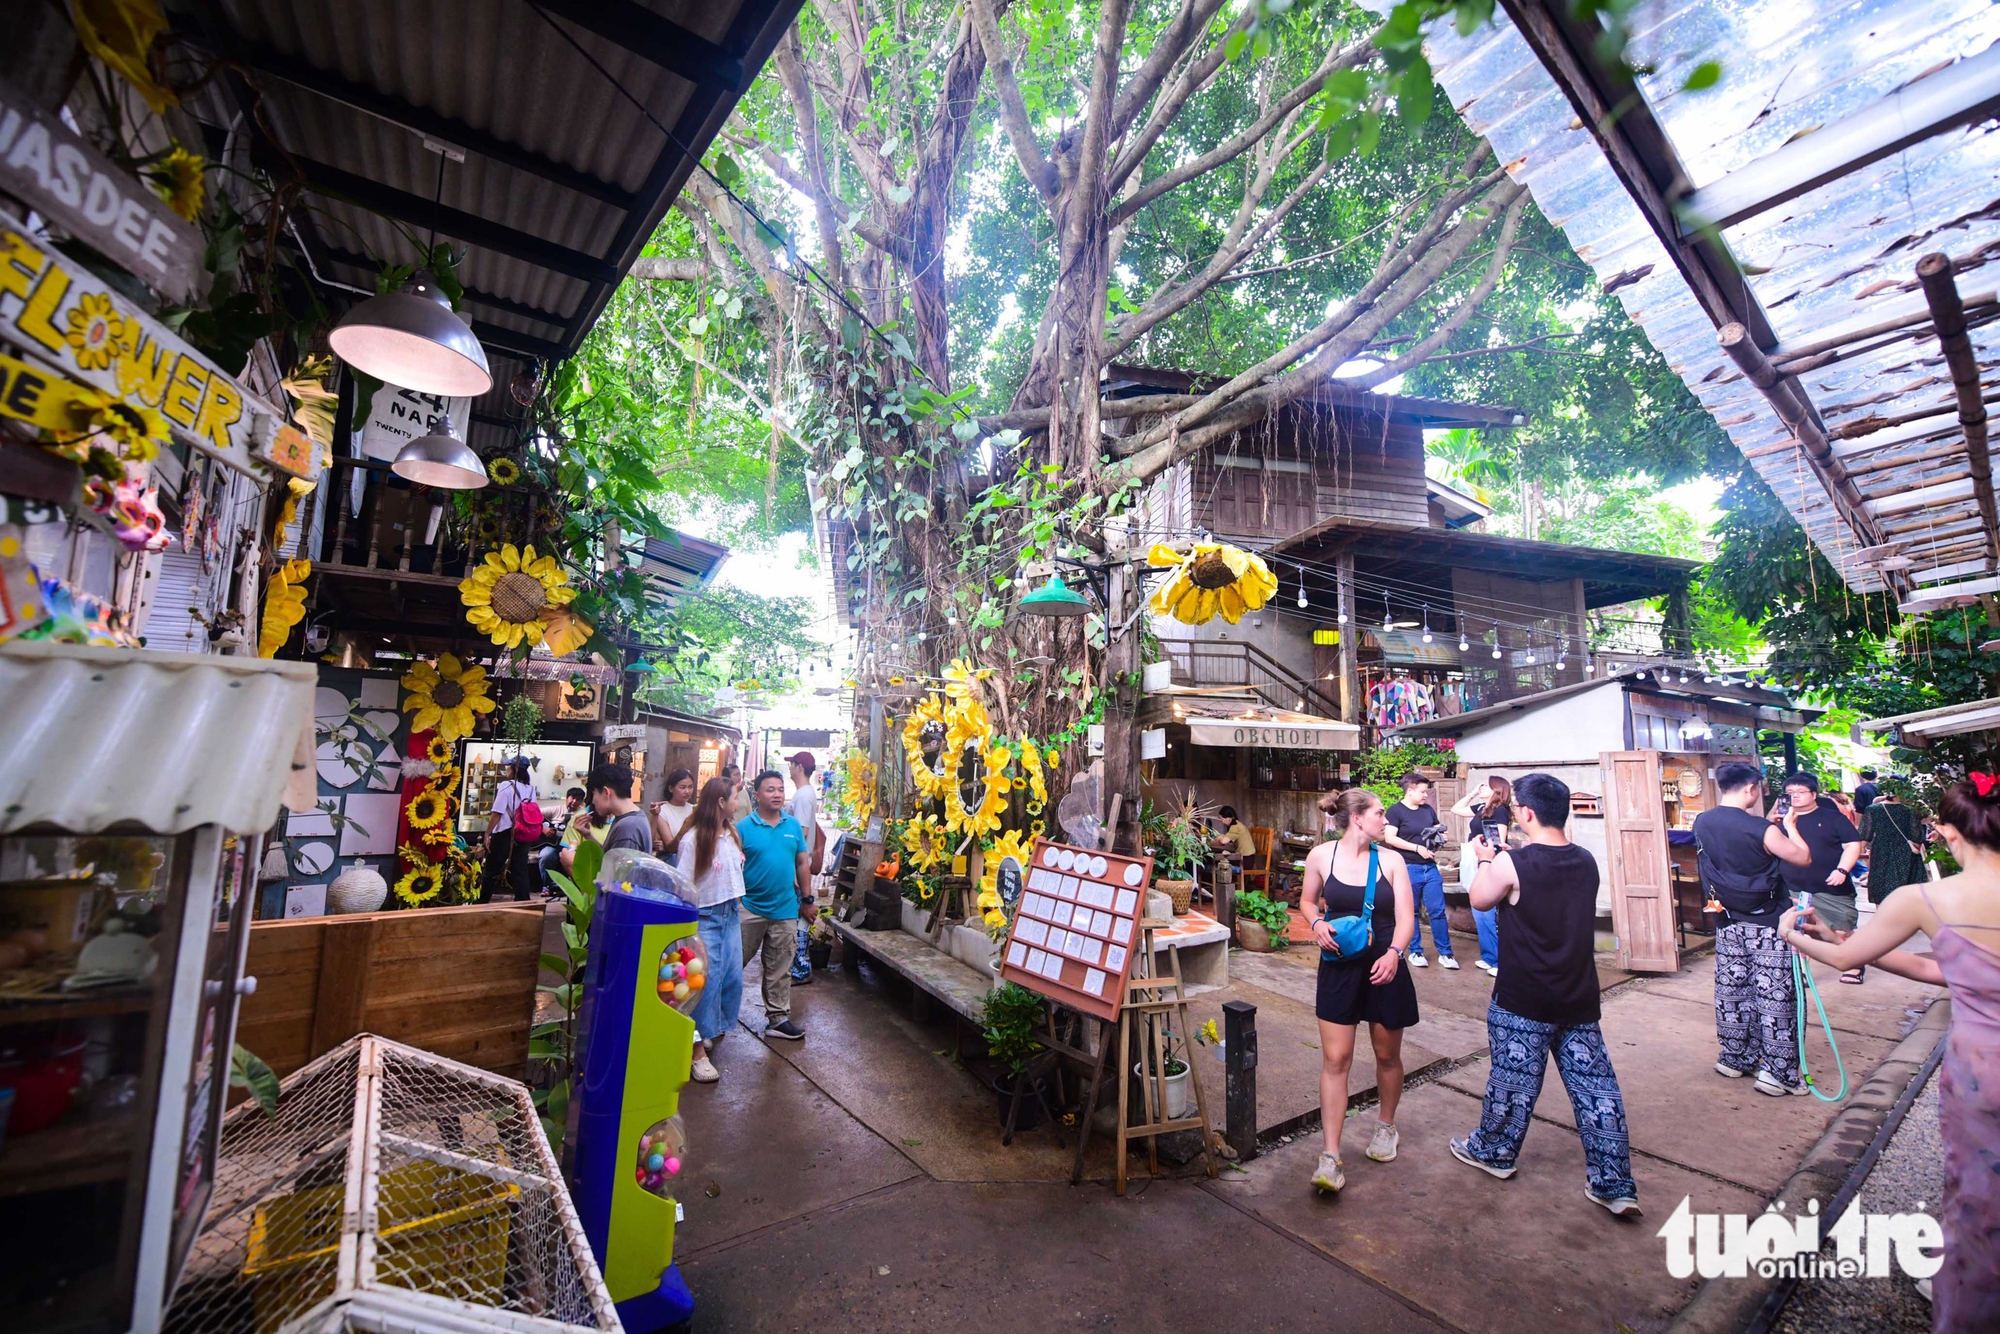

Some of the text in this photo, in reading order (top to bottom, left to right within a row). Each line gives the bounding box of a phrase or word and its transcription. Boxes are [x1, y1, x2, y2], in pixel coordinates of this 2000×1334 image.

[375, 420, 412, 439] TWENTY
[617, 727, 644, 738] Toilet
[1234, 728, 1321, 745] OBCHOEI
